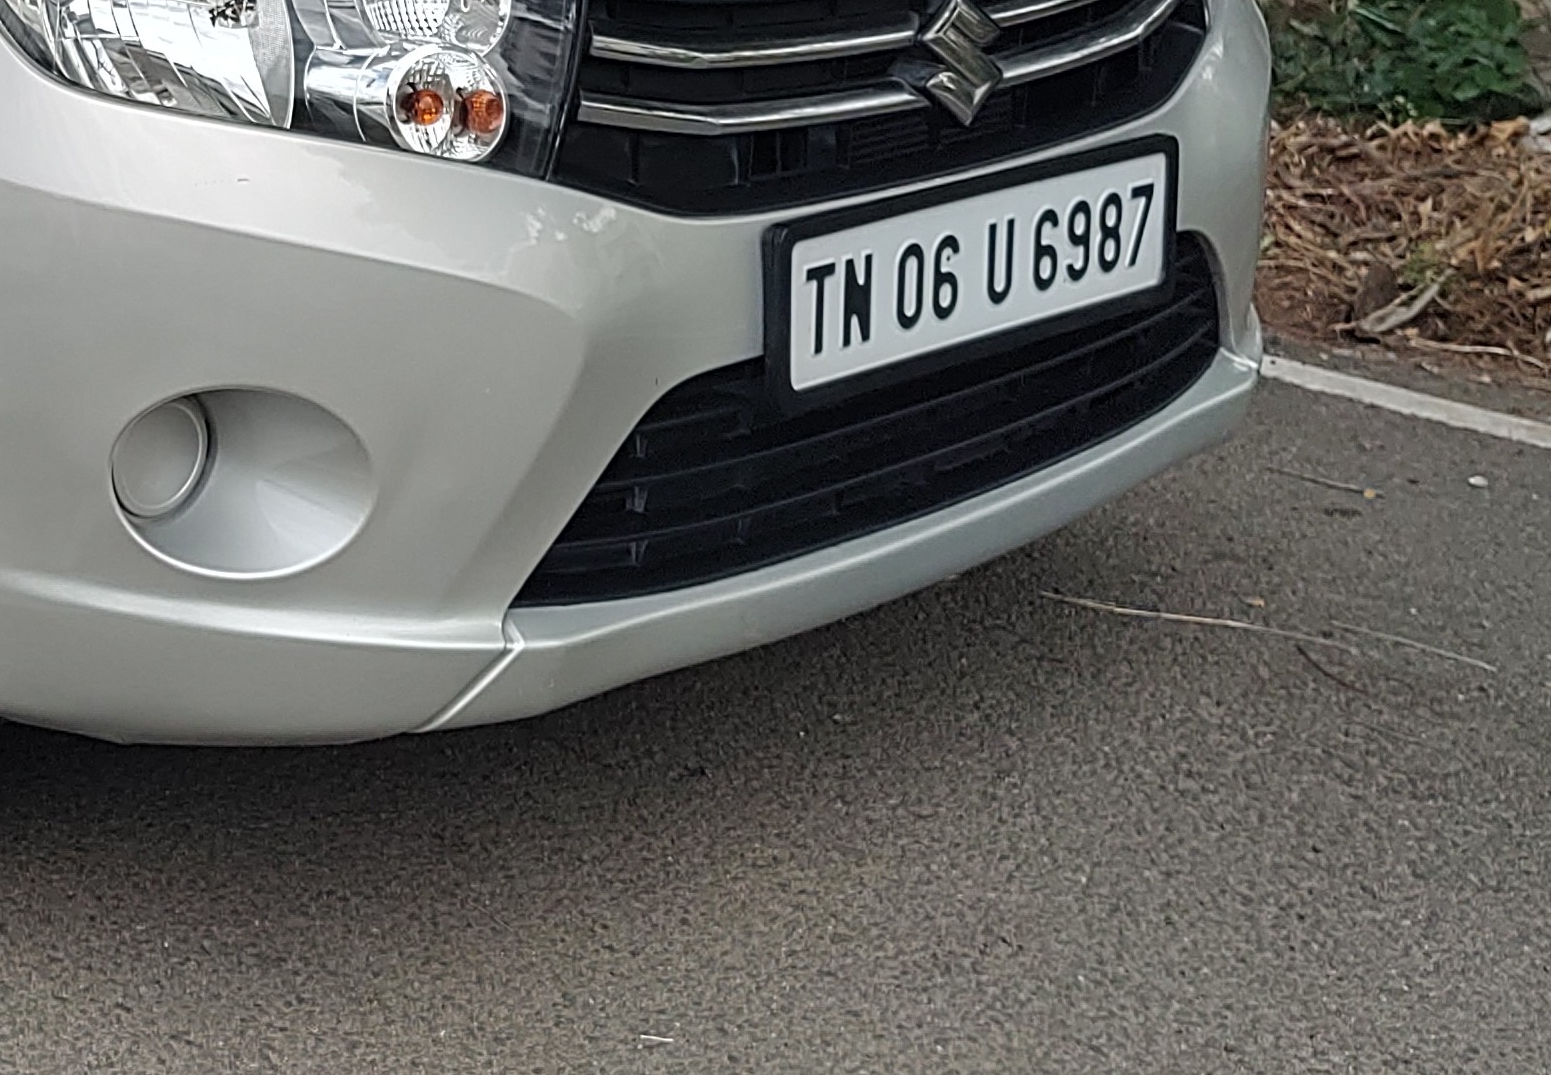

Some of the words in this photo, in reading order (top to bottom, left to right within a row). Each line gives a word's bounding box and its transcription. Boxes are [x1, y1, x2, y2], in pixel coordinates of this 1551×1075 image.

[805, 252, 873, 356] TN
[896, 234, 960, 330] 06
[986, 217, 1016, 306] U
[1032, 182, 1156, 292] 6987
